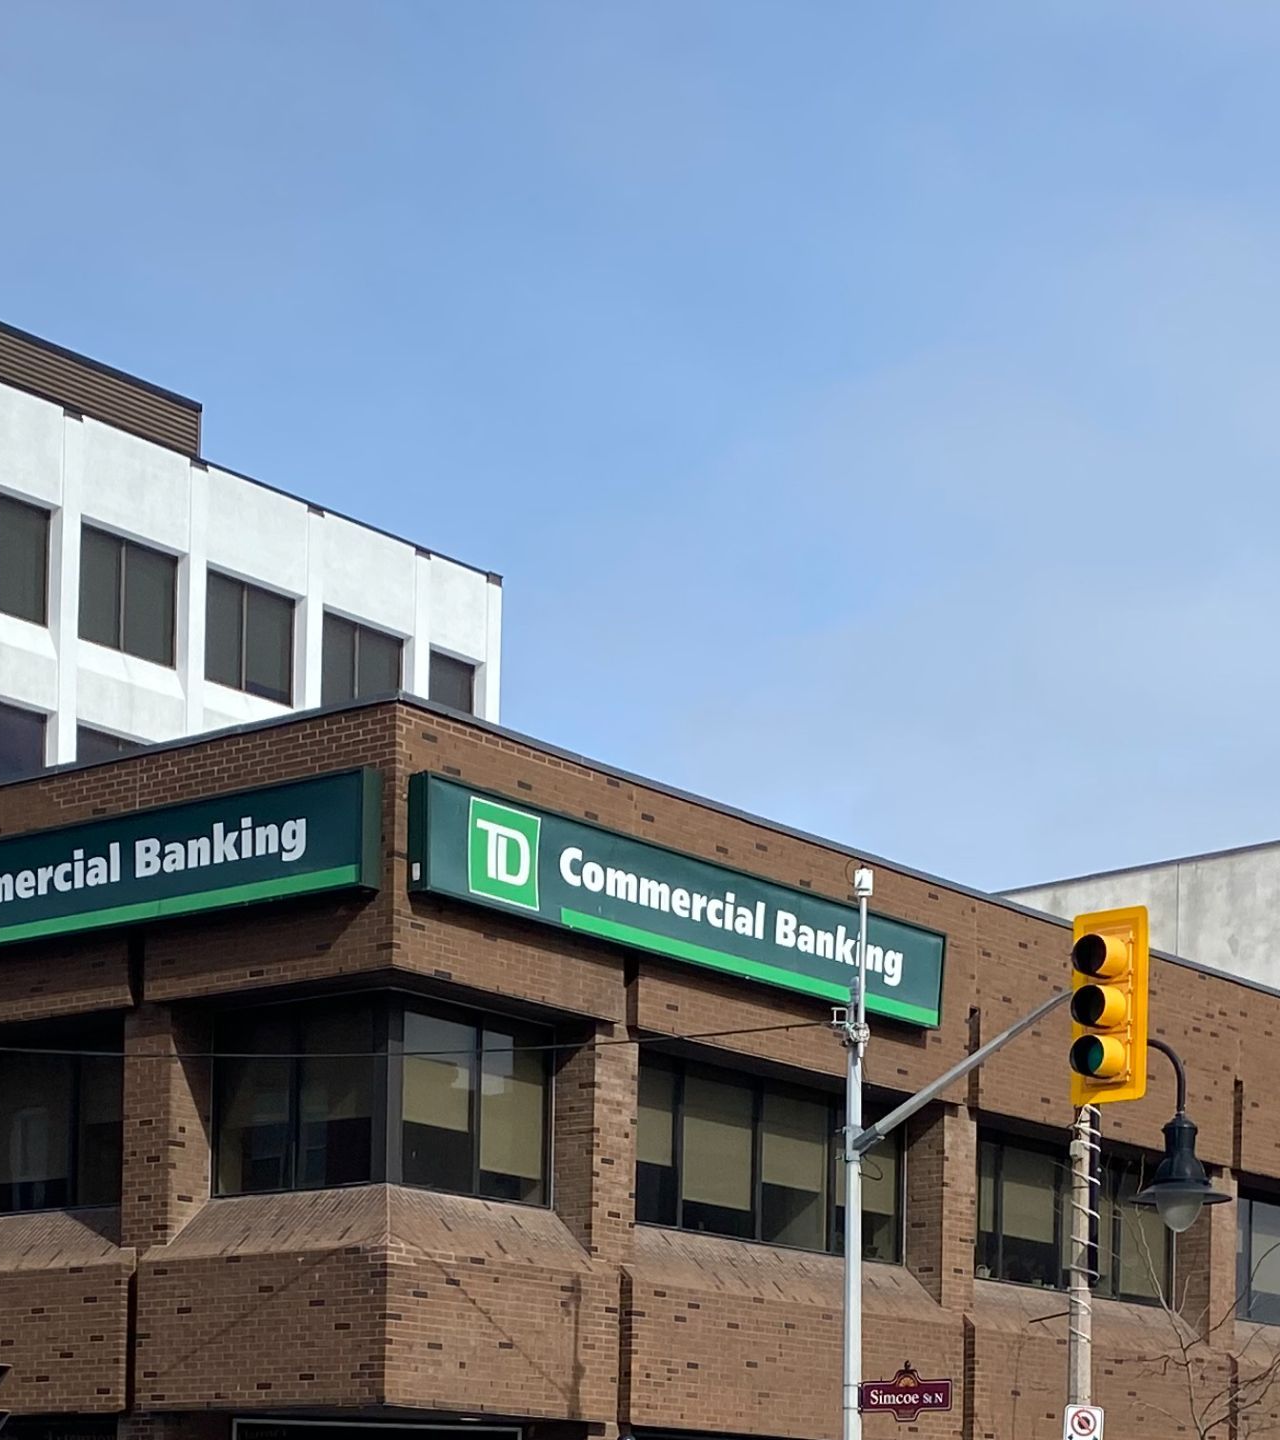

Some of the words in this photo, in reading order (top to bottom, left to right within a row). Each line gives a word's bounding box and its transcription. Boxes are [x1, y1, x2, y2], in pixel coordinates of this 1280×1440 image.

[134, 815, 308, 878] Banking
[475, 817, 531, 886] TD
[558, 847, 766, 941] Commercial
[870, 1389, 919, 1405] Simcoe
[934, 1393, 943, 1404] N
